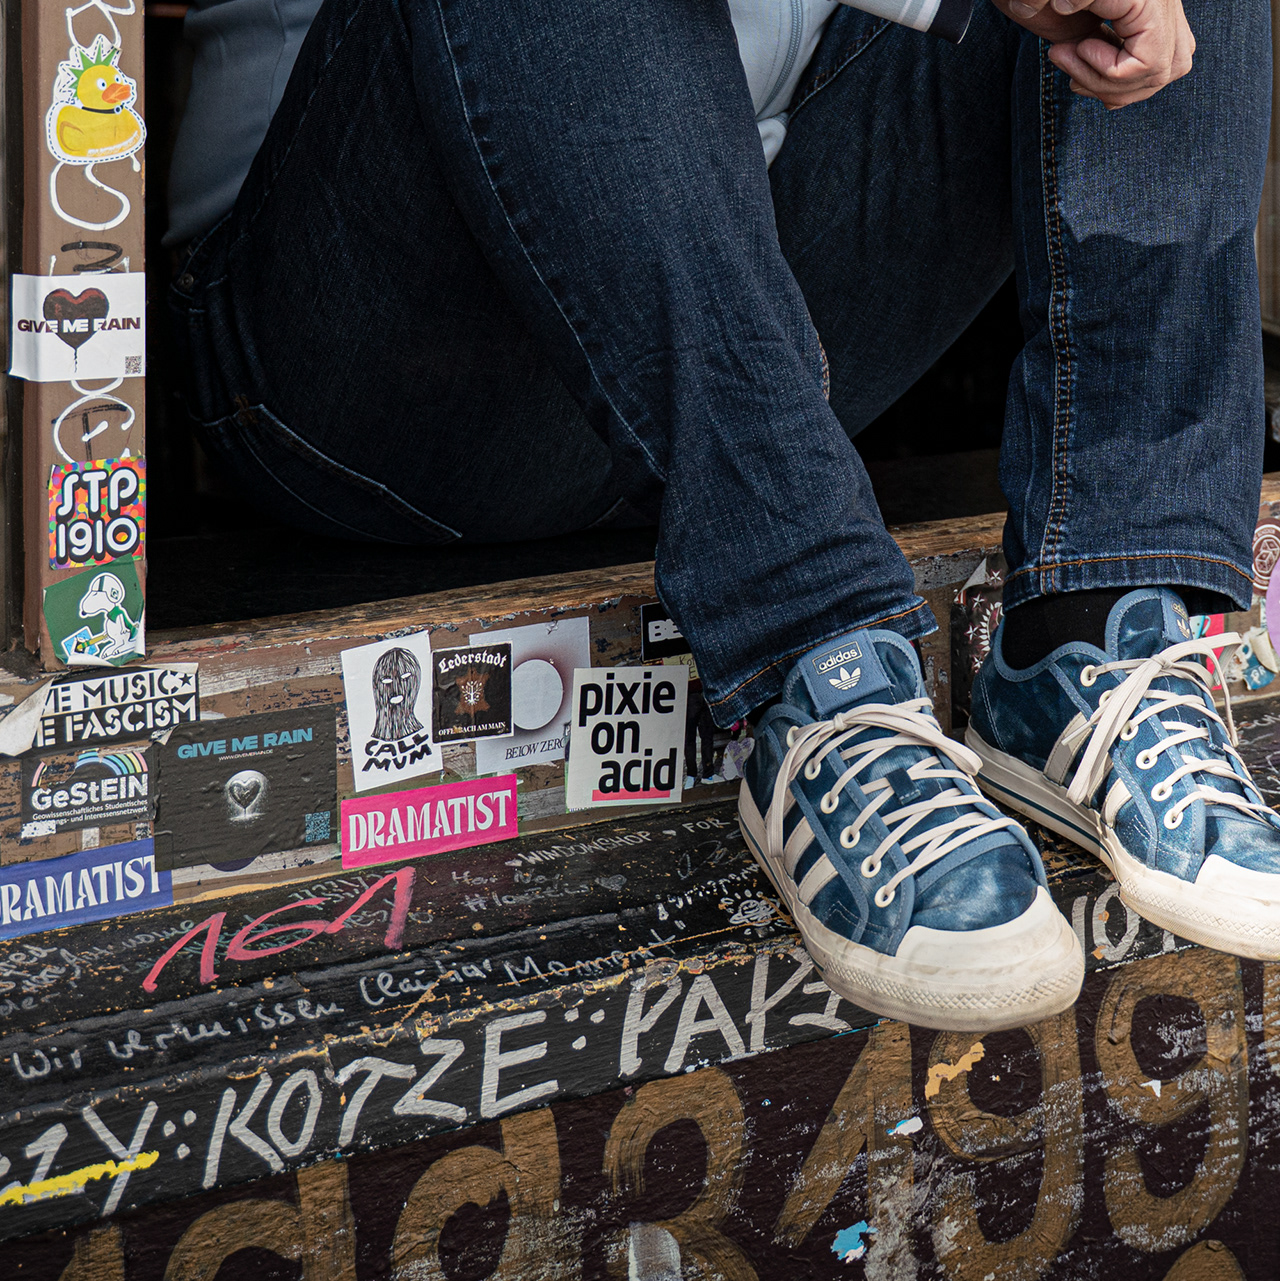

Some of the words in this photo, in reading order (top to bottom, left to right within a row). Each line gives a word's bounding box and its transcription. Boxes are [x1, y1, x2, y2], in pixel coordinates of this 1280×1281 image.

[17, 319, 59, 334] GIVE
[62, 318, 91, 333] ME
[97, 316, 141, 332] RAIN
[56, 467, 137, 517] STP
[55, 516, 139, 564] 1910
[438, 650, 508, 675] Lederstadt
[817, 646, 858, 672] adidas
[83, 669, 180, 710] MUSIC
[578, 671, 676, 727] pixie
[67, 694, 198, 743] FASCISM
[590, 719, 641, 756] on
[176, 739, 227, 760] GIVE
[230, 735, 261, 753] ME
[262, 727, 314, 747] RAIN
[364, 733, 430, 758] CALL
[505, 743, 540, 760] BELOW
[597, 748, 677, 794] acid
[30, 772, 149, 812] GeStEIN
[348, 788, 513, 853] DRAMATIST
[202, 1012, 561, 1193] KOTZE
